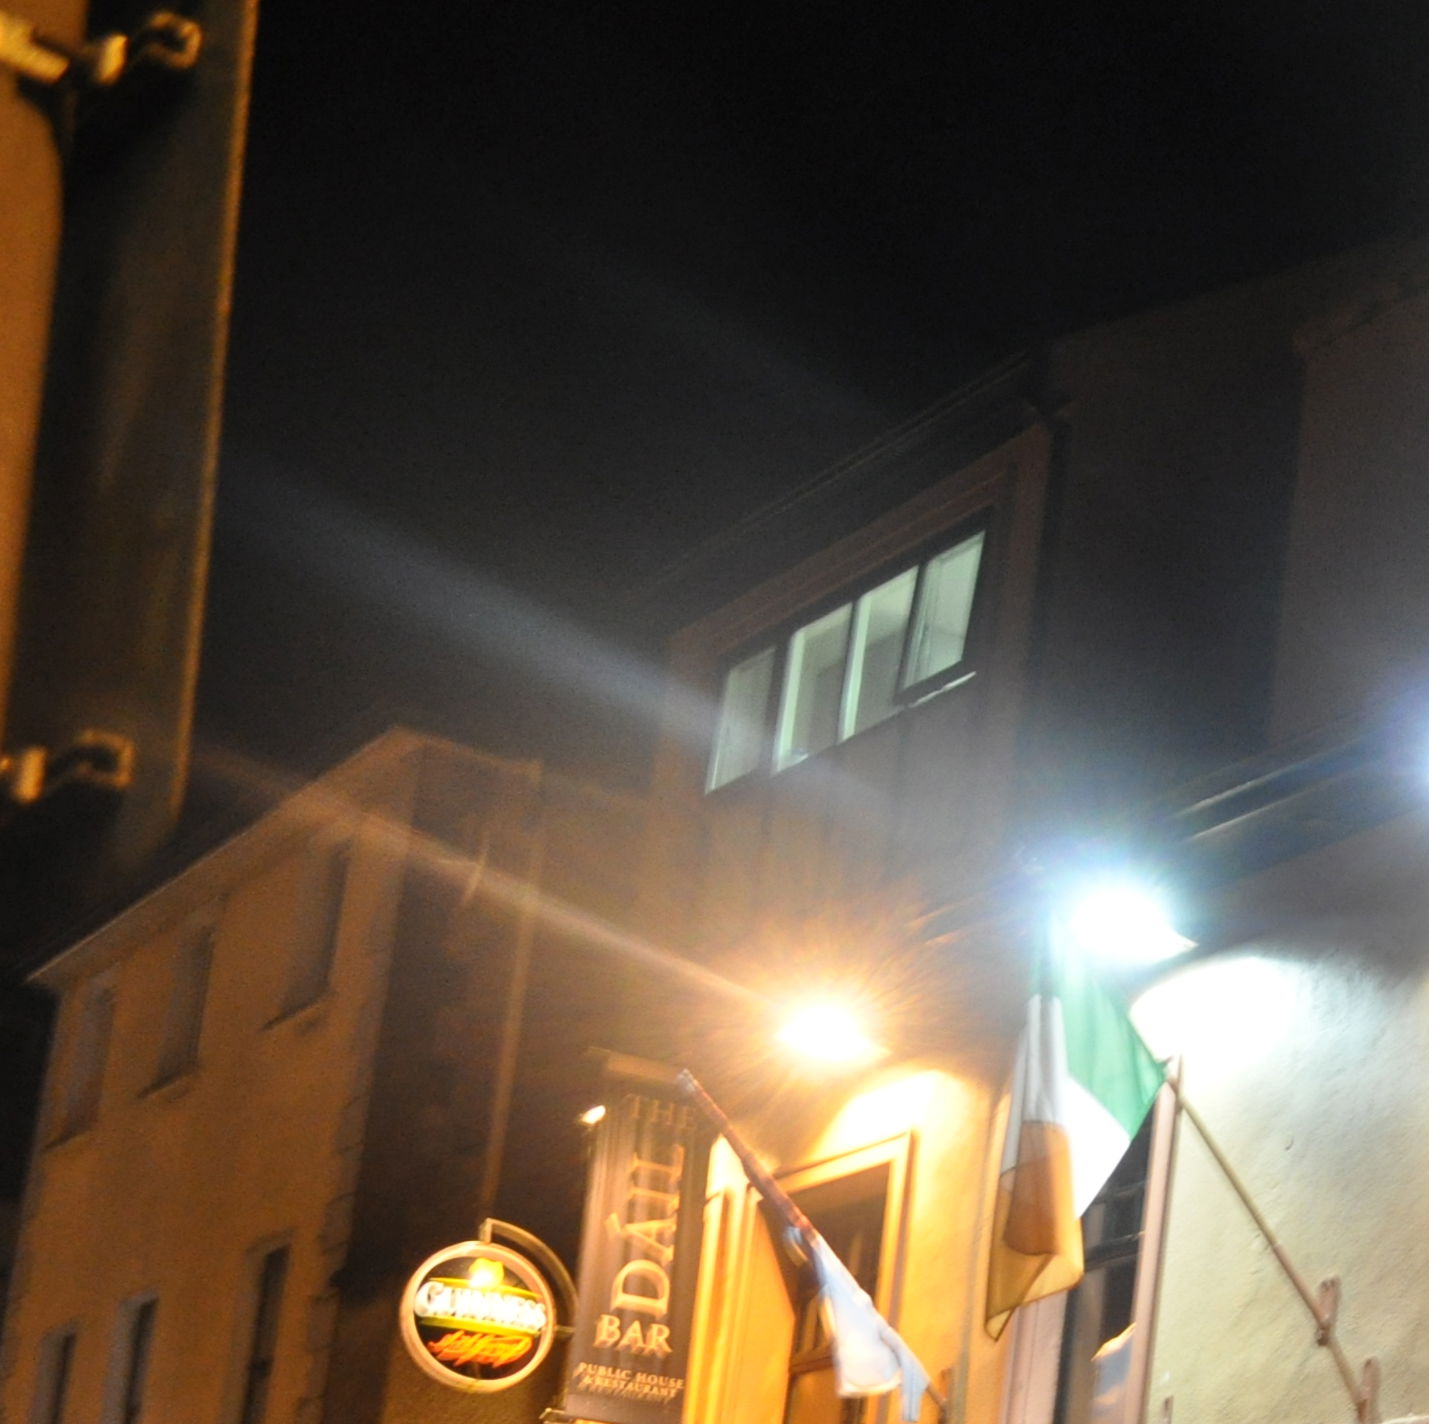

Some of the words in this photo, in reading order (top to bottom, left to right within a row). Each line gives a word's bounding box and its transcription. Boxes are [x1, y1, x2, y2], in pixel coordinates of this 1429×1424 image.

[604, 1144, 684, 1317] DÁIL
[593, 1313, 674, 1358] BAR
[573, 1362, 633, 1381] PUBLIC
[635, 1372, 685, 1391] HOUSE
[594, 1377, 679, 1402] RESTAURANT
